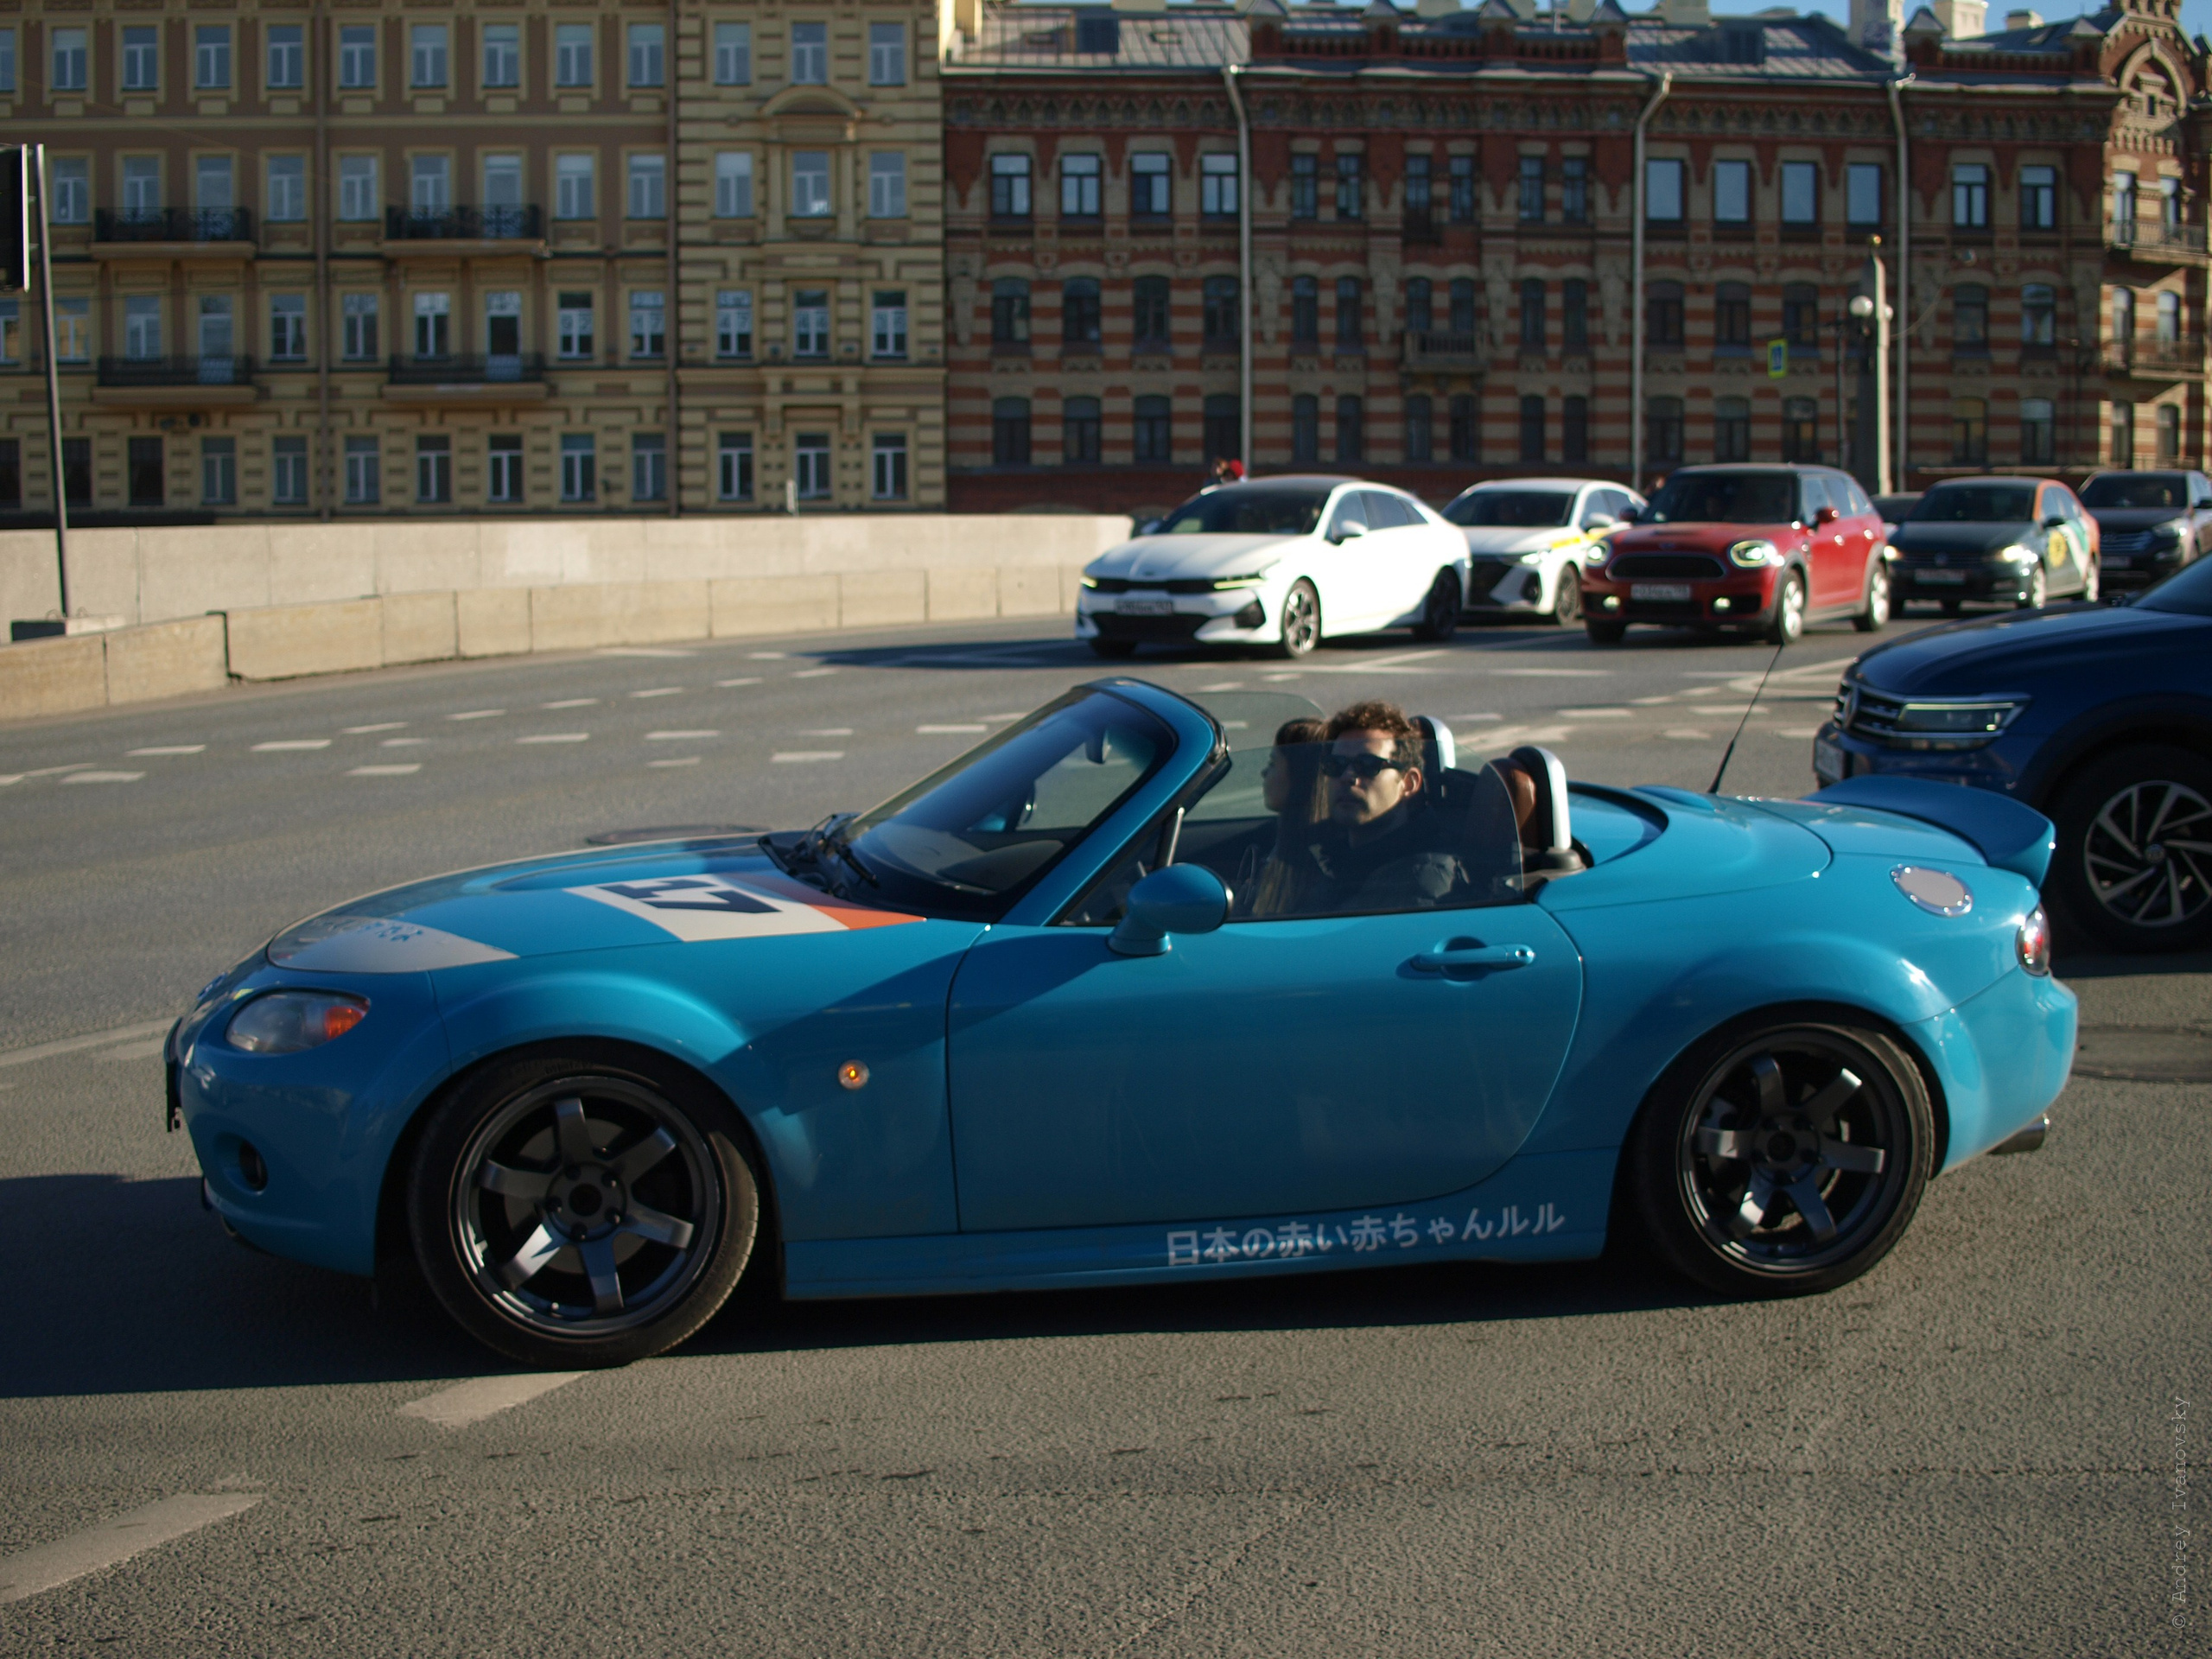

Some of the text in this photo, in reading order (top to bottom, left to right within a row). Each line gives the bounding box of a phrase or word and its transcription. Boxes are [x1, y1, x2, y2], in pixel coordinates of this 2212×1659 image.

[595, 879, 784, 913] 17
[1166, 1202, 1566, 1267] 日本の赤い赤ちゃんルル
